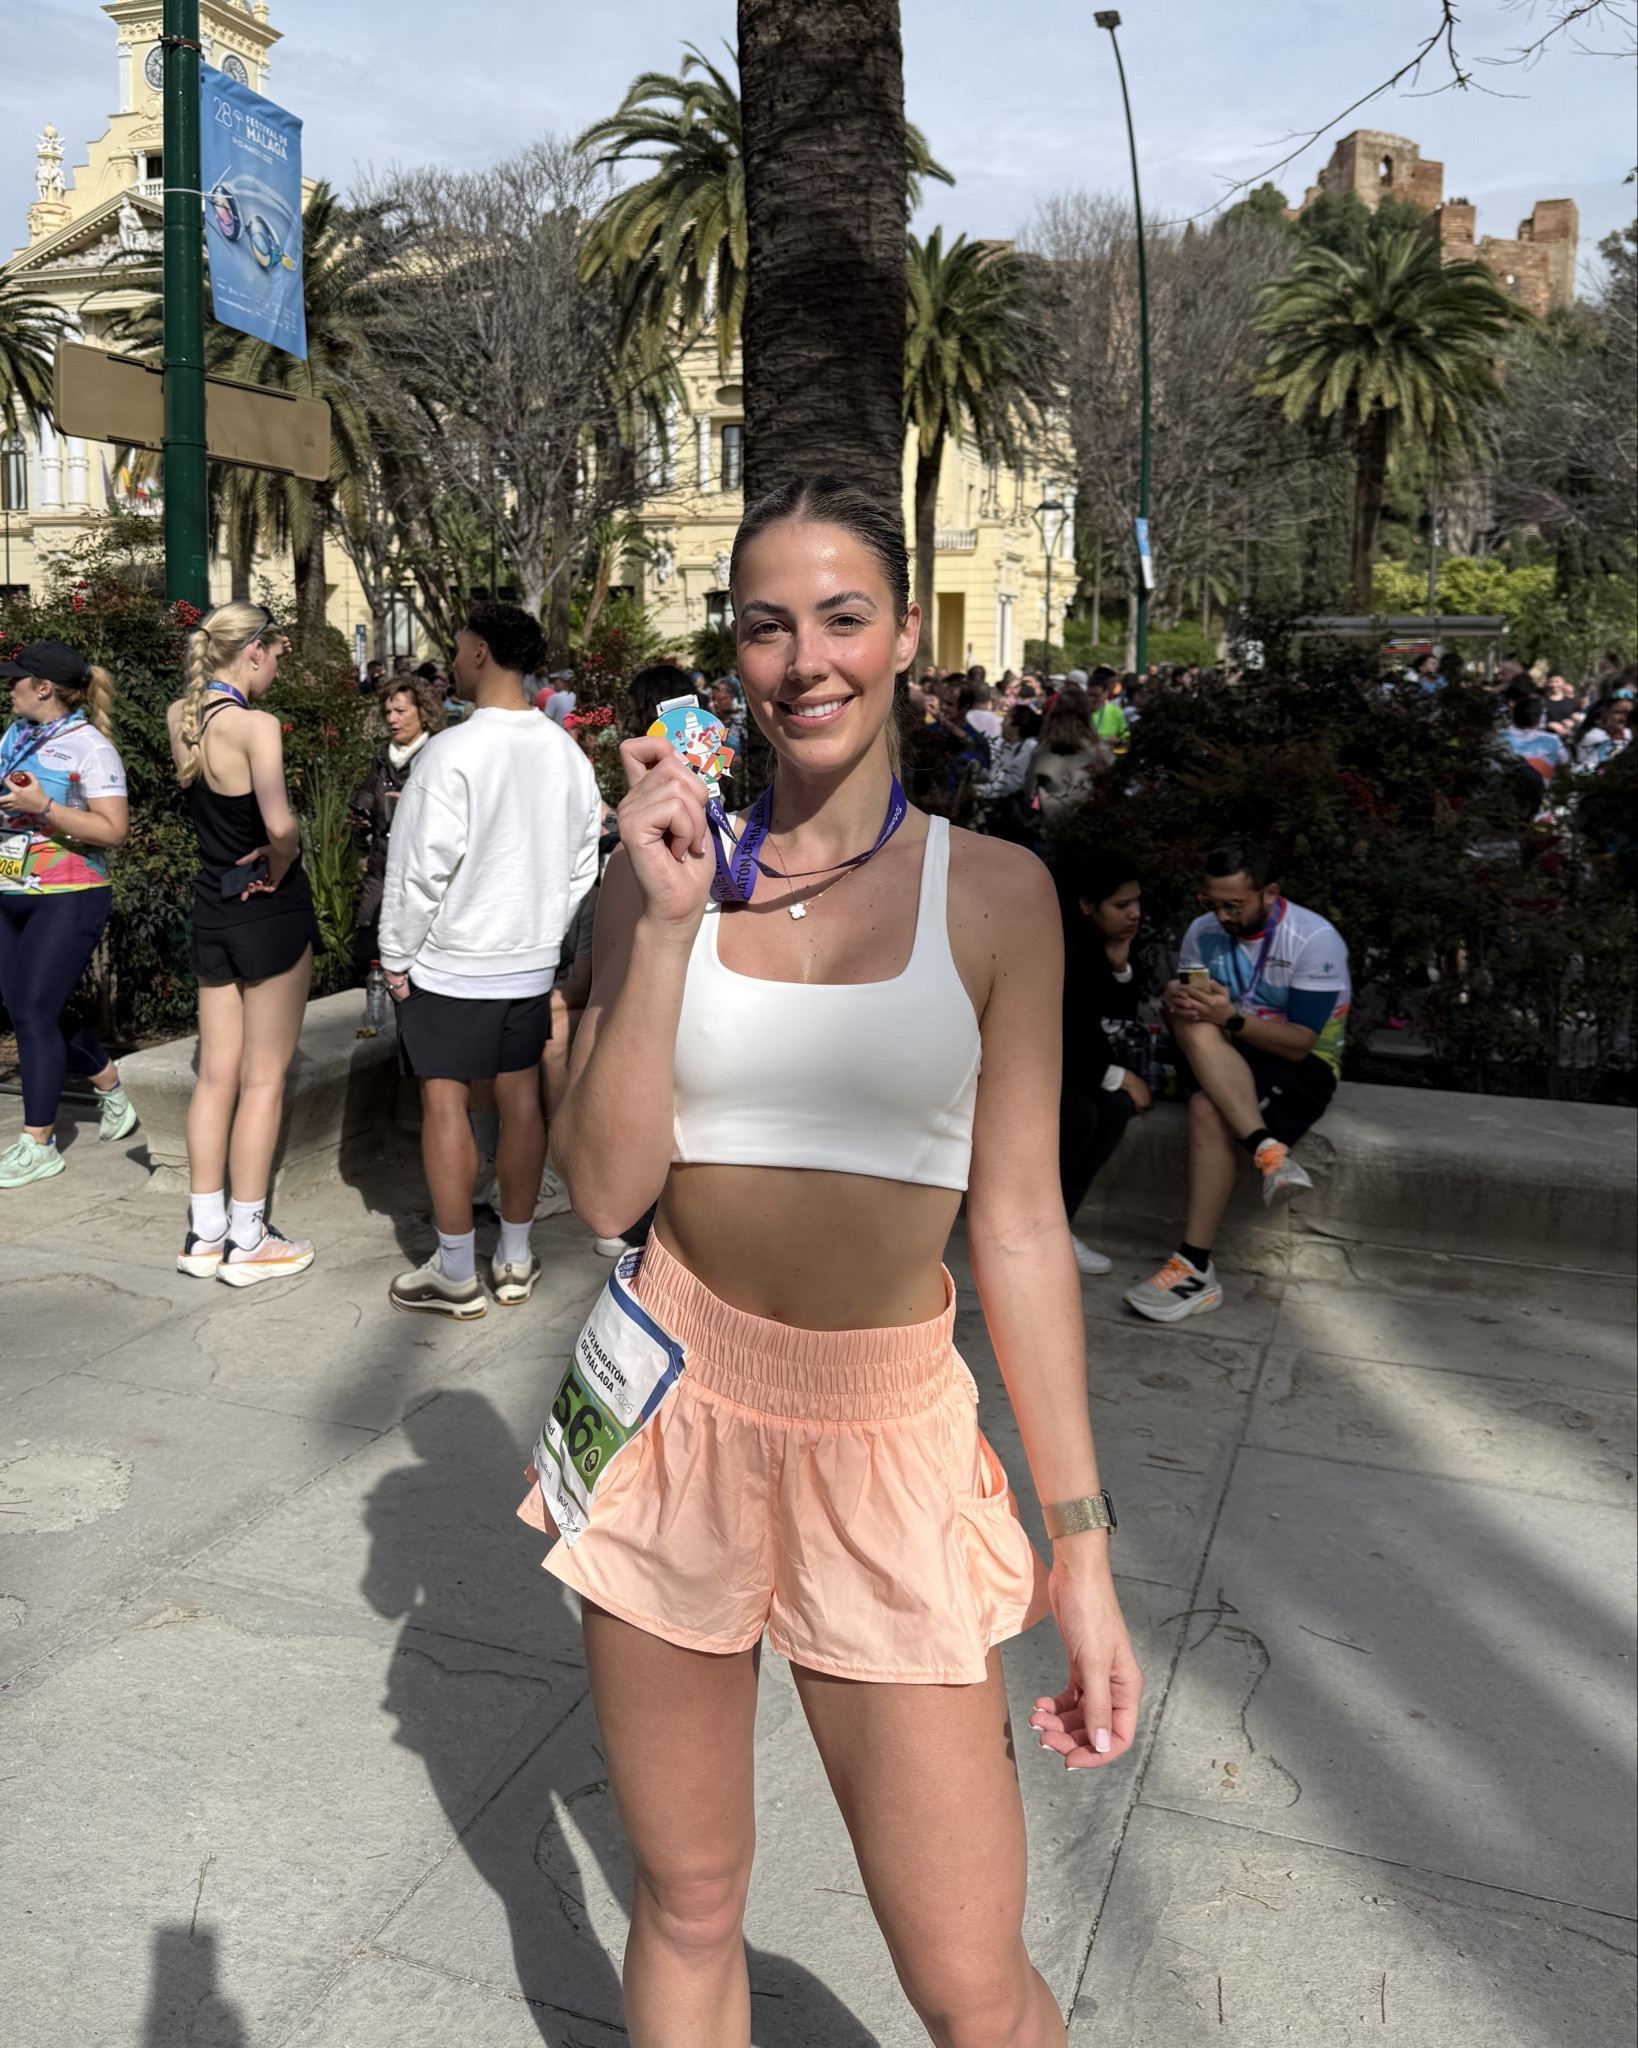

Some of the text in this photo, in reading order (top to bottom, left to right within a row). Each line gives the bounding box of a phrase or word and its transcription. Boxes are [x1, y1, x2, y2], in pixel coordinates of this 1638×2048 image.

[214, 96, 233, 128] 28
[246, 115, 288, 146] FESTIVAL DE
[581, 1339, 635, 1415] DE MÁLAGA 2025
[587, 1327, 627, 1387] 1/2 MARATÓN
